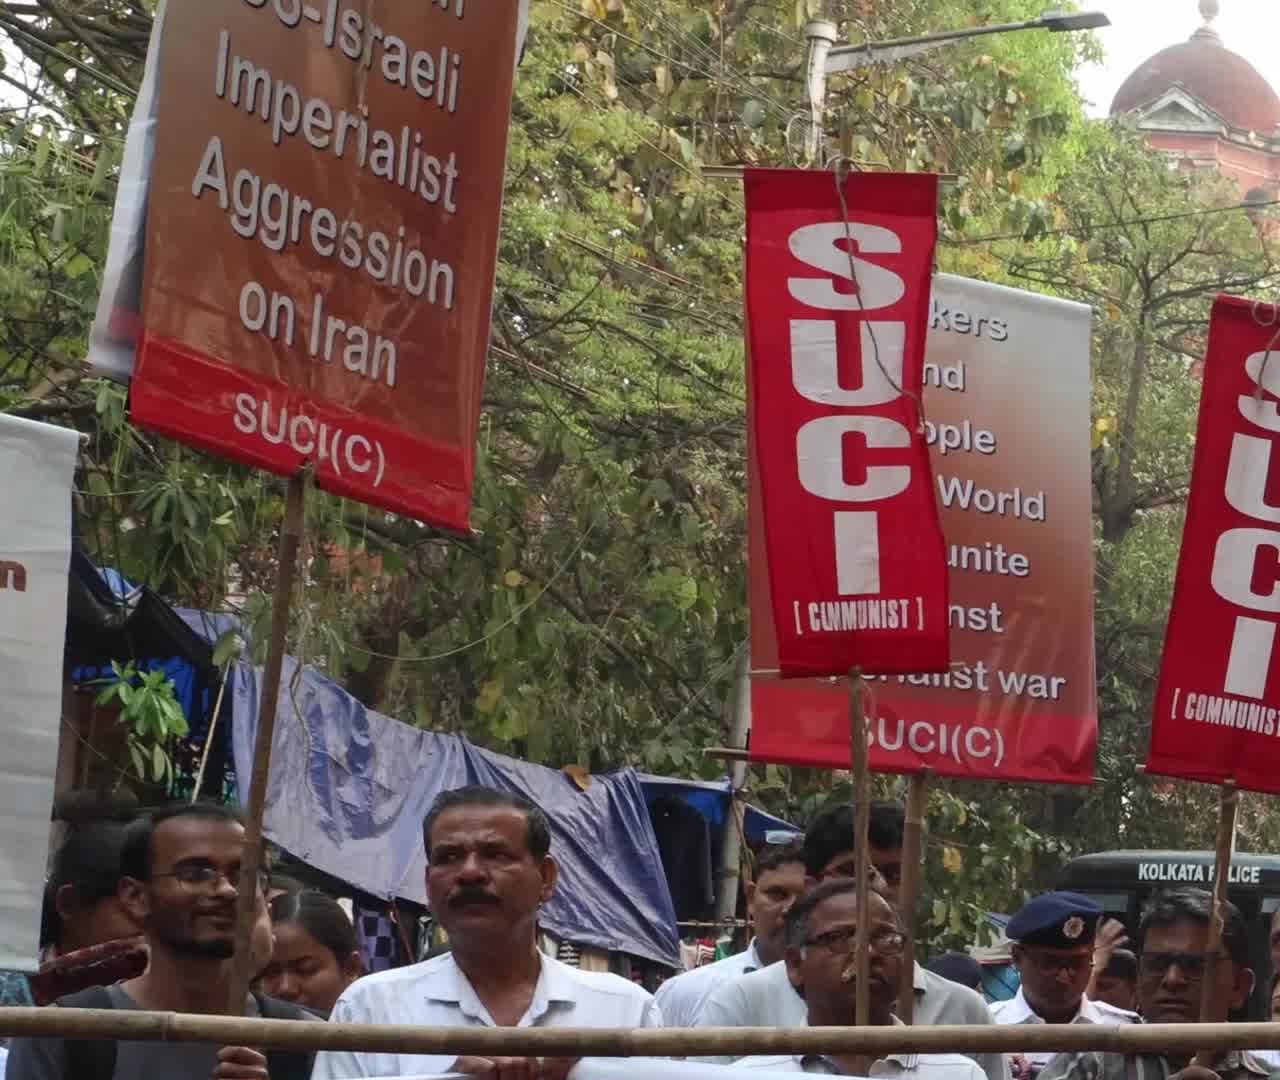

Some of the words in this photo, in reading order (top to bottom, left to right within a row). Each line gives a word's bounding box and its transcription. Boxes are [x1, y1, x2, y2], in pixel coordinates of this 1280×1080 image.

[243, 0, 461, 112] -Israeli
[216, 30, 458, 213] Imperialist
[192, 136, 455, 309] Aggression
[239, 280, 295, 346] on
[309, 293, 397, 388] Iran
[930, 300, 1008, 341] kers
[787, 222, 911, 595] SUCI
[922, 360, 966, 391] nd
[233, 392, 385, 487] SUCI(C)
[938, 475, 1047, 521] World
[998, 669, 1066, 700] war
[1138, 863, 1204, 881] KOLKATA
[1208, 865, 1261, 883] PLICE
